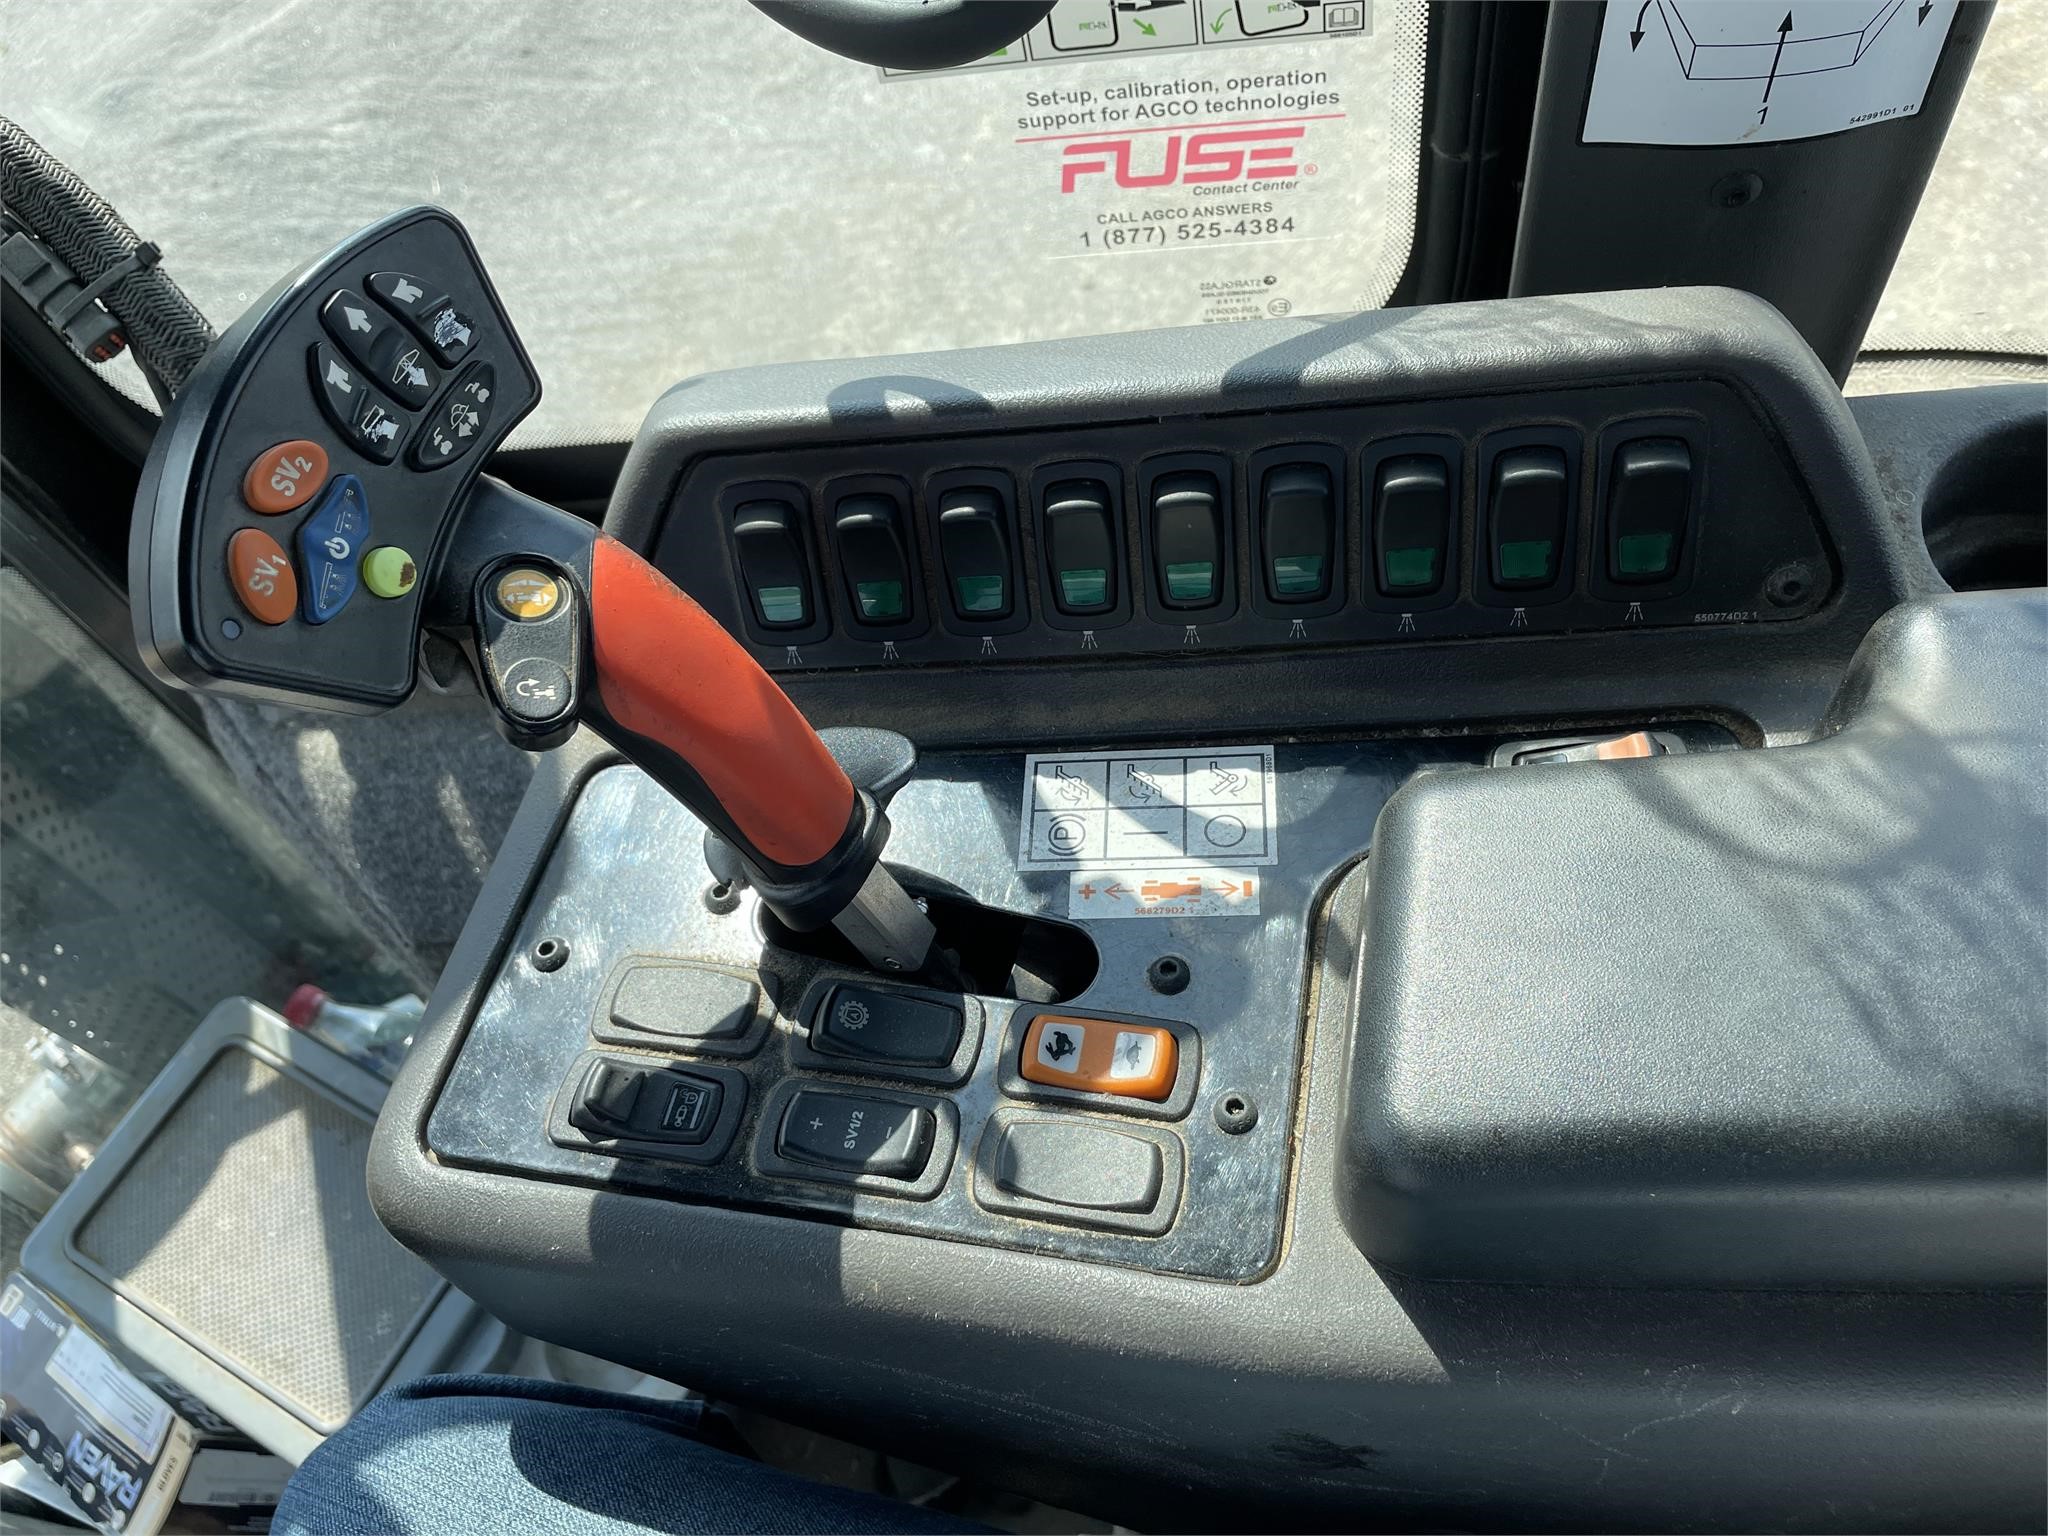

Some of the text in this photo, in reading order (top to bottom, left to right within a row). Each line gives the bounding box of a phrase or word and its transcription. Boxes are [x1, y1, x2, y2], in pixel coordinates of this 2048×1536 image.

[1026, 70, 1327, 108] Set-up, calibration, operation
[1903, 104, 1915, 112] 01
[1017, 90, 1341, 131] support for AGCO technologies
[1757, 106, 1769, 125] 1
[1061, 126, 1306, 194] FUSE
[1192, 179, 1299, 197] Contact Center
[1080, 216, 1296, 249] 1 (877) 525-4384
[1097, 202, 1274, 225] CALL AGCO ANSWERS
[271, 456, 313, 497] SV2
[248, 554, 287, 596] SV1
[1694, 611, 1749, 622] 550774D2
[844, 1110, 864, 1150] SV1/2
[64, 1430, 144, 1511] RAVEN
